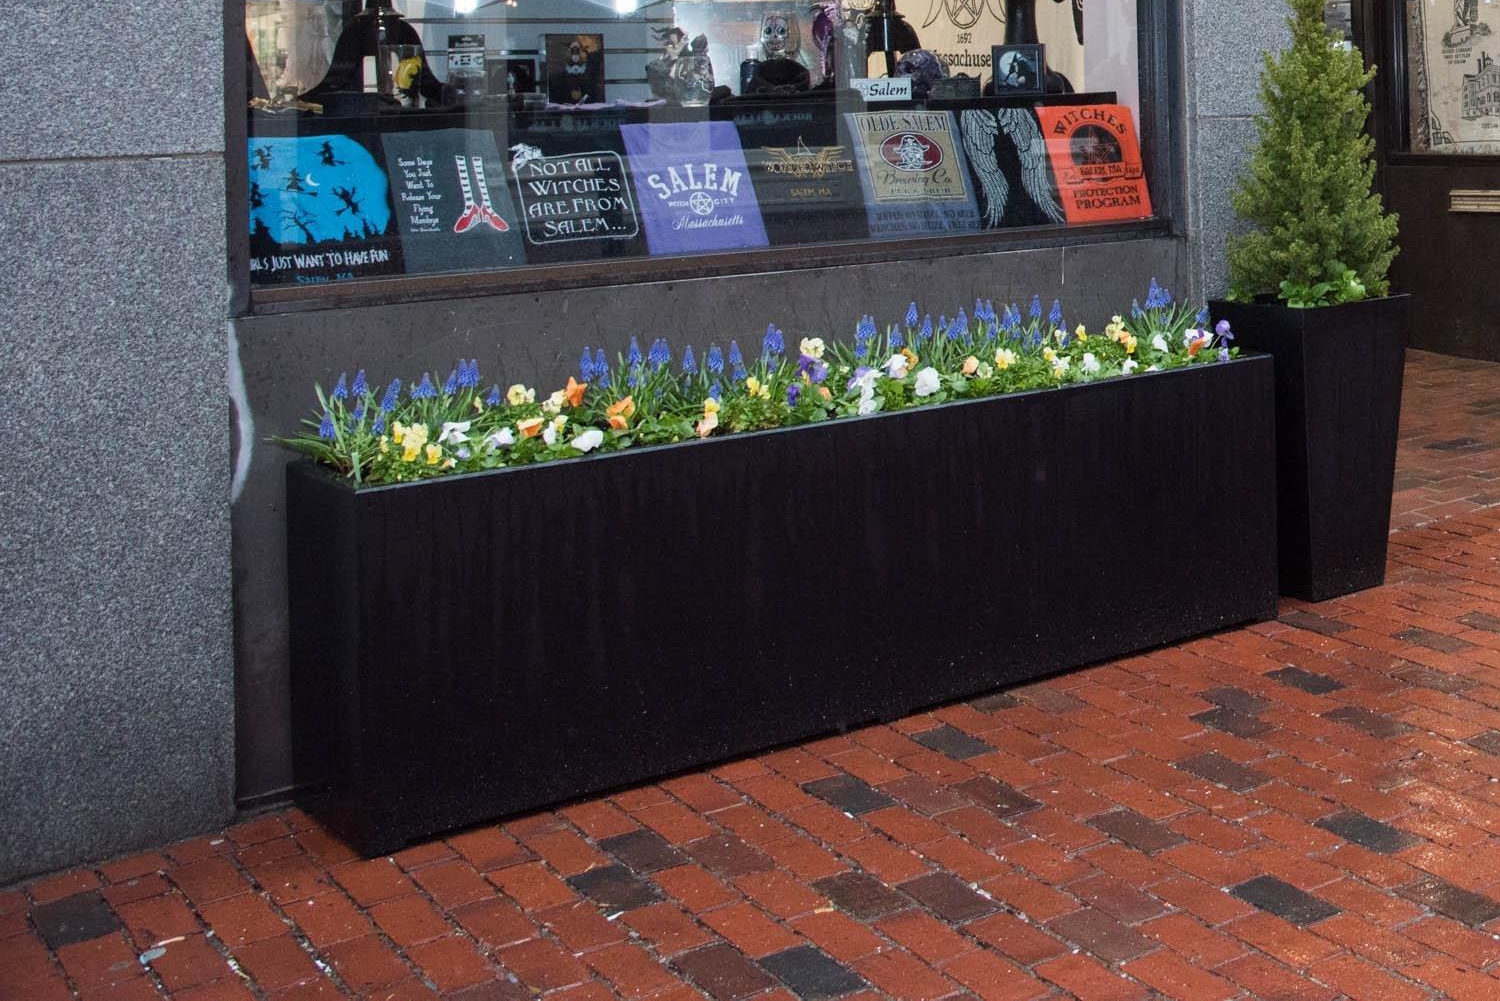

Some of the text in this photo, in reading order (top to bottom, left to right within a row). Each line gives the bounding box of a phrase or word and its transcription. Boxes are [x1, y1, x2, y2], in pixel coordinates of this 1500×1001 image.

[957, 32, 972, 44] 1692
[869, 82, 908, 96] Salem
[860, 114, 948, 132] OLDE SALEM
[1054, 108, 1127, 135] WITCHES
[529, 158, 611, 177] NOT ALL
[425, 179, 434, 188] To
[528, 178, 620, 196] WITCHES
[647, 163, 742, 200] SALEM
[1073, 185, 1138, 199] PROTECTION
[528, 197, 628, 218] ARE FROM
[714, 197, 736, 206] CITY
[1076, 195, 1141, 210] PROGRAM
[672, 214, 744, 230] Massachusetts
[272, 255, 292, 272] JUST
[294, 253, 325, 269] WANT
[326, 251, 343, 267] TO
[344, 250, 369, 266] HAVE
[370, 249, 389, 263] FUN
